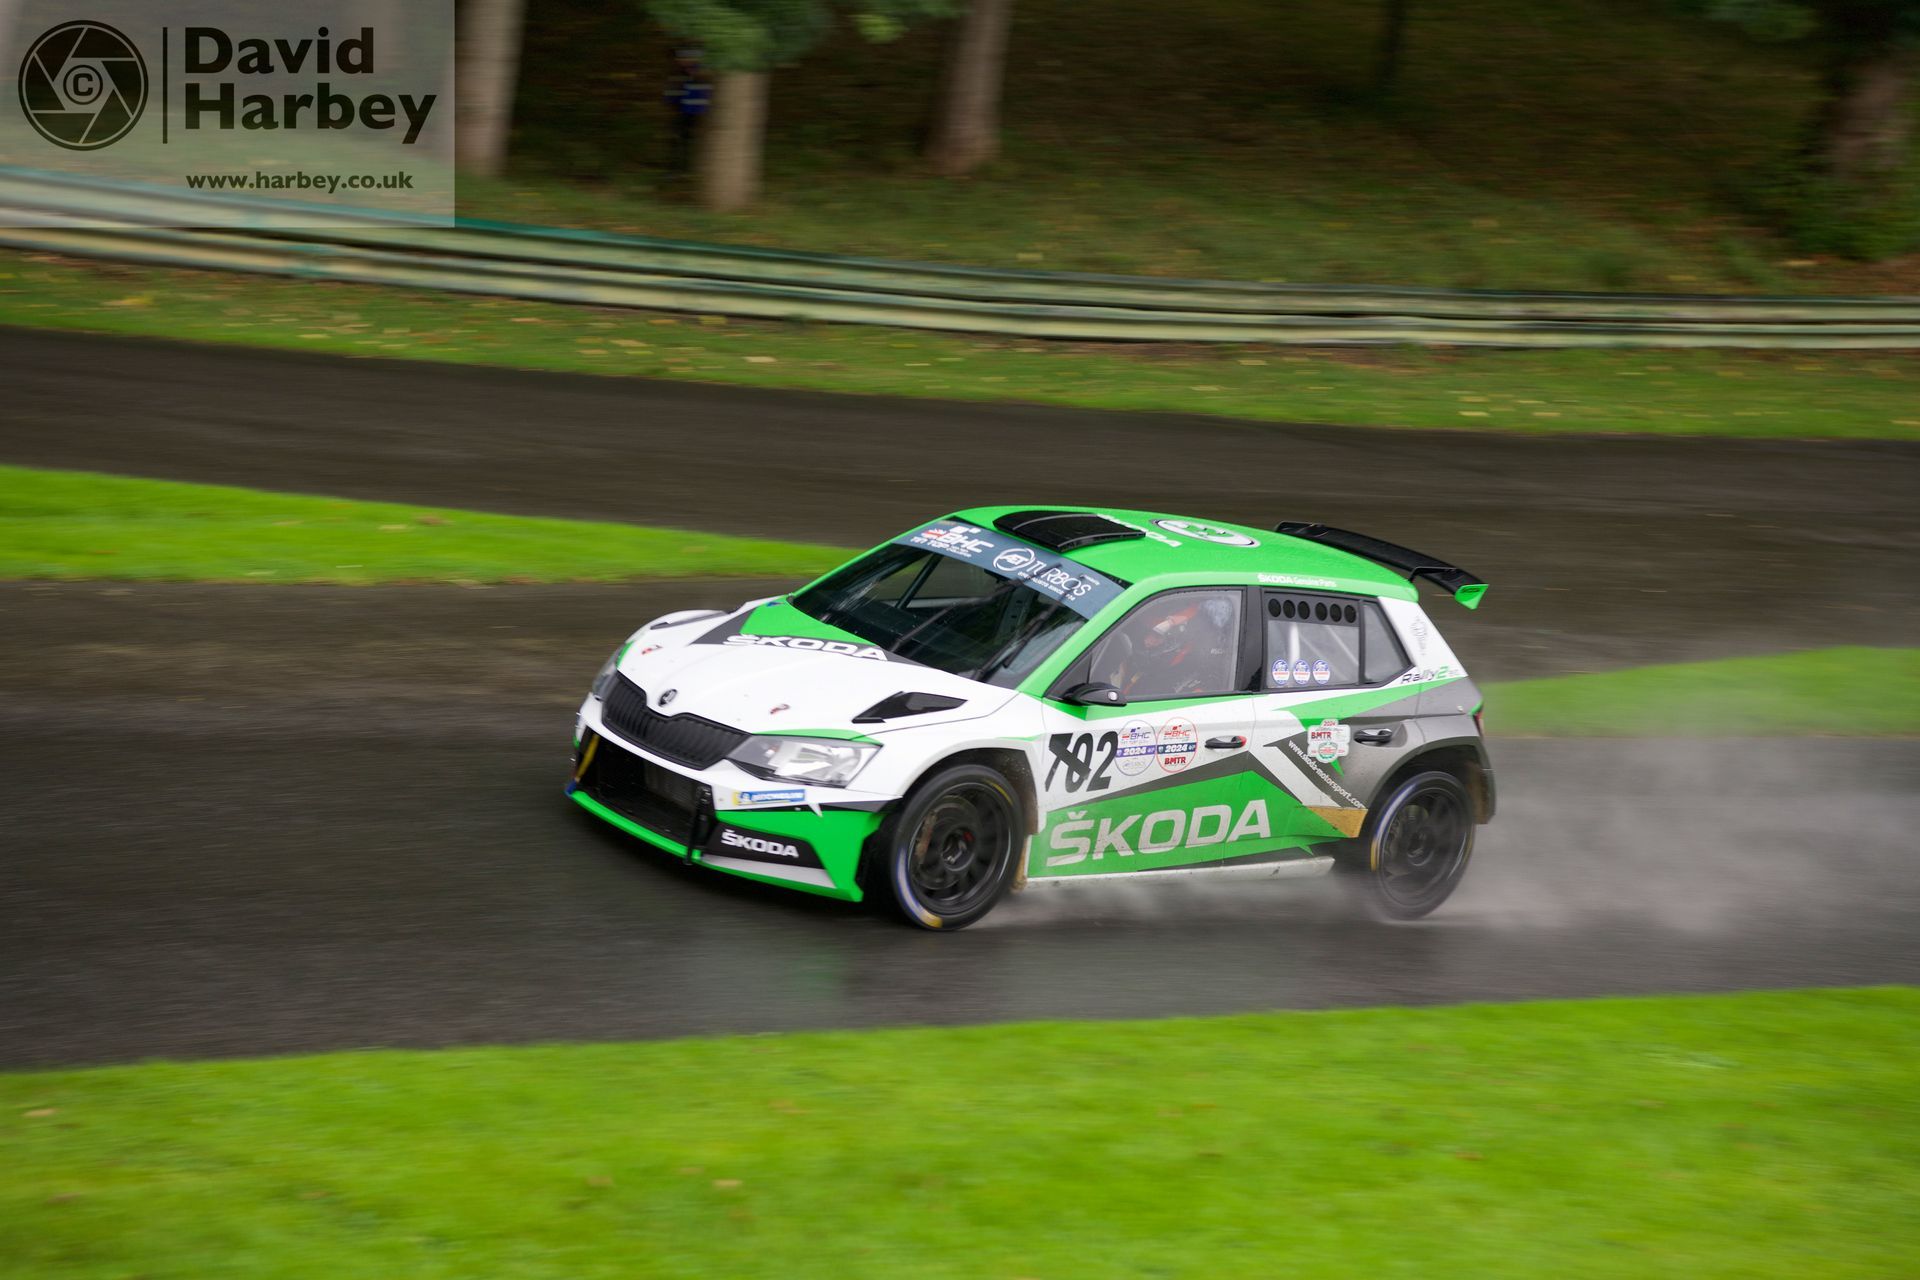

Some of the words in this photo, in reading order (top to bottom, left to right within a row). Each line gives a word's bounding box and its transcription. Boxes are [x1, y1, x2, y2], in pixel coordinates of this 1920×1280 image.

[722, 633, 888, 662] ŠKODA
[1311, 731, 1331, 740] BMTR
[1123, 746, 1147, 756] 2024
[1165, 744, 1188, 753] 2024
[1164, 756, 1186, 765] BMTR
[1046, 799, 1271, 868] ŠKODA
[721, 828, 799, 859] ŠKODA
